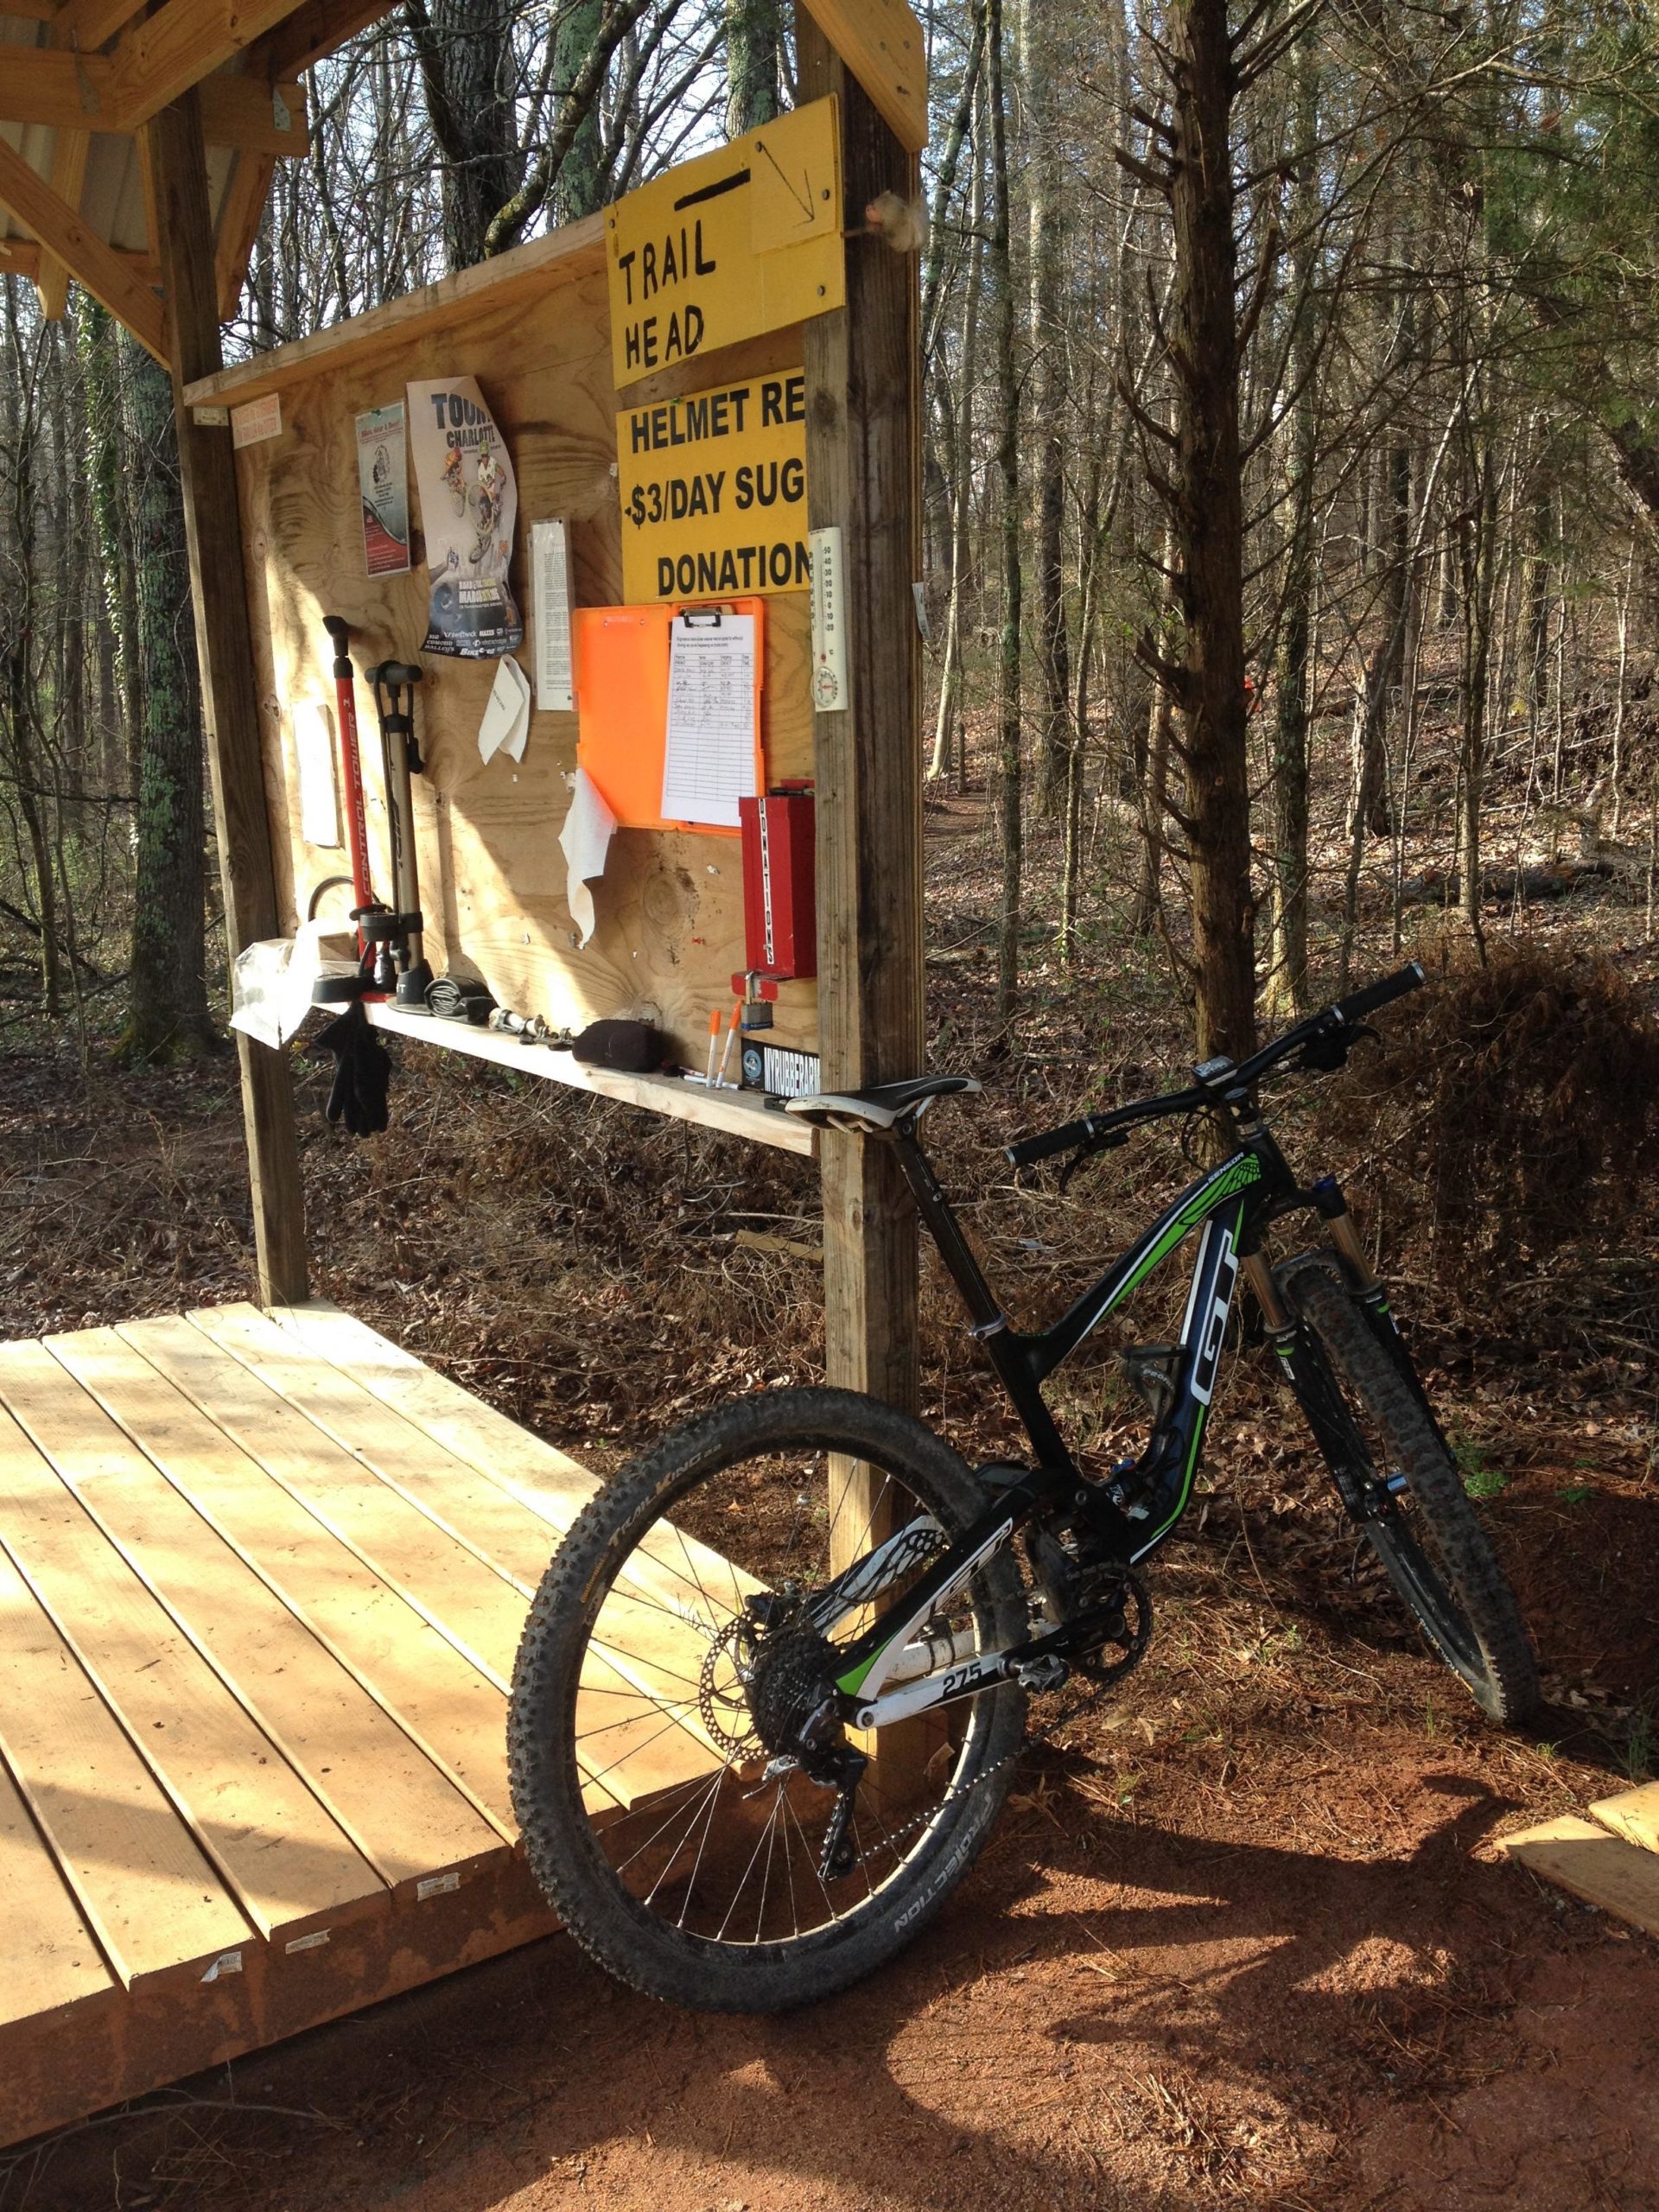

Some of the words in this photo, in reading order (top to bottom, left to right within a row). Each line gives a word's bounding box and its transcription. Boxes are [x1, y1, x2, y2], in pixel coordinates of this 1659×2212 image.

[619, 219, 716, 305] TRAIL
[626, 304, 705, 370] HEAD
[446, 424, 496, 448] CHARLOTTE
[631, 387, 750, 454] HELMET
[631, 471, 727, 531] $3/DAY
[735, 457, 805, 510] SUG
[658, 540, 810, 597] DONATION
[348, 714, 362, 791] TOWER
[355, 794, 371, 896] CONTROL
[759, 798, 774, 964] DONATIONS
[1207, 1151, 1245, 1185] SENSOR
[655, 1452, 702, 1495] KING
[893, 1792, 994, 1935] PROTECTION
